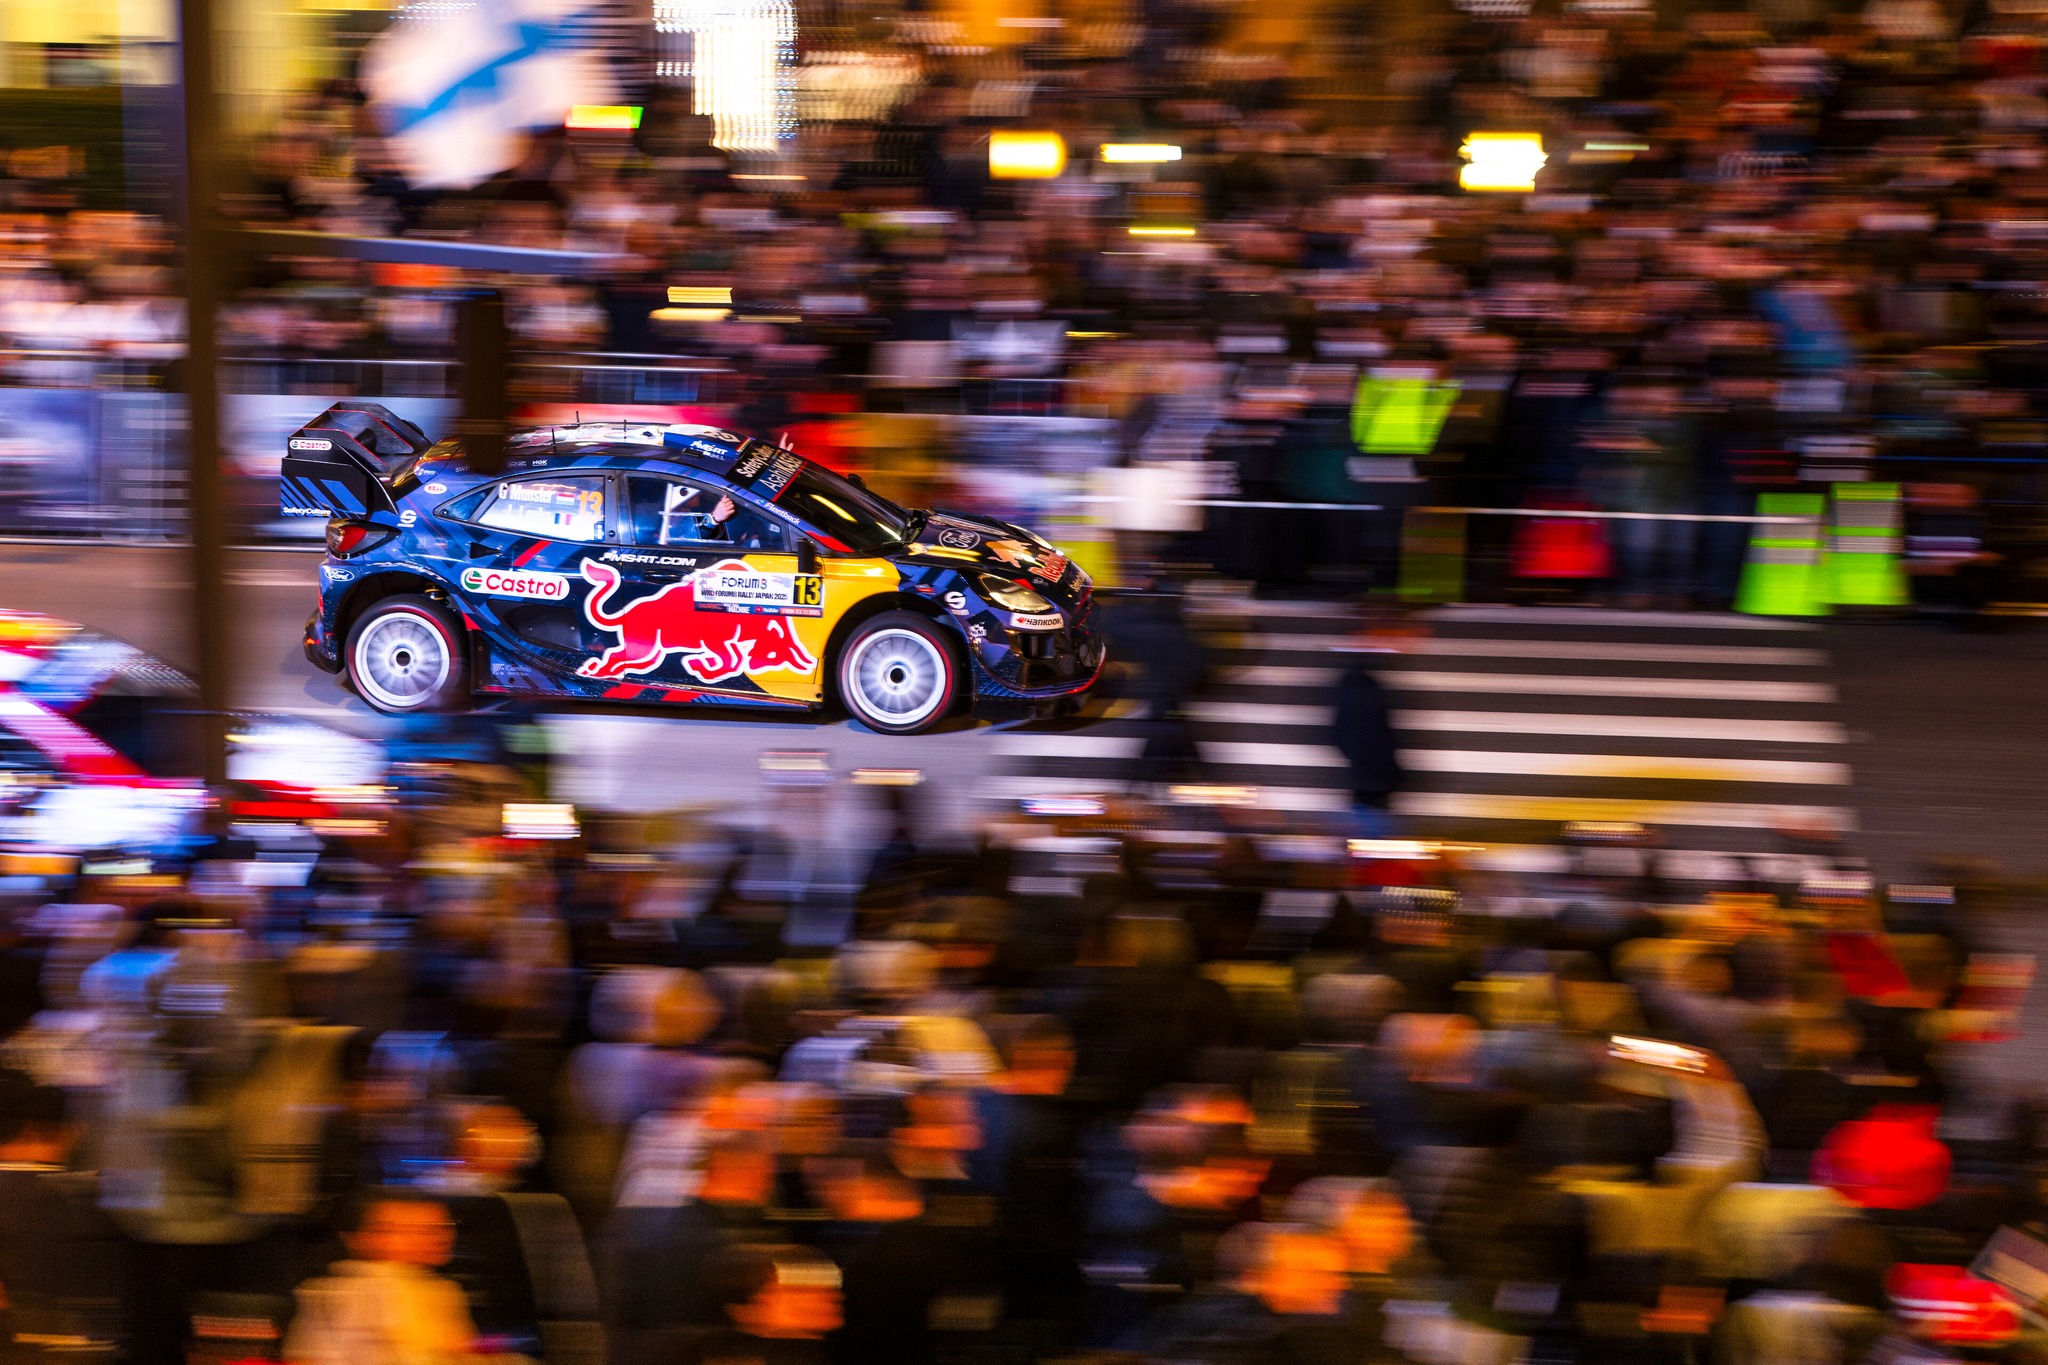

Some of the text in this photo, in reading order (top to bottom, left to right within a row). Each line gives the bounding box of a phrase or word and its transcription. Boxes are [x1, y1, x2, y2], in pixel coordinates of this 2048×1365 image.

[300, 441, 330, 449] Castrol
[499, 483, 507, 500] G
[283, 507, 331, 515] SafetyCulture
[577, 490, 604, 524] 13
[764, 502, 801, 525] Fleetback
[486, 573, 563, 597] Castrol
[794, 577, 821, 605] 13
[738, 591, 754, 599] RALLY
[755, 592, 774, 600] JAPAN
[774, 593, 788, 601] 2025
